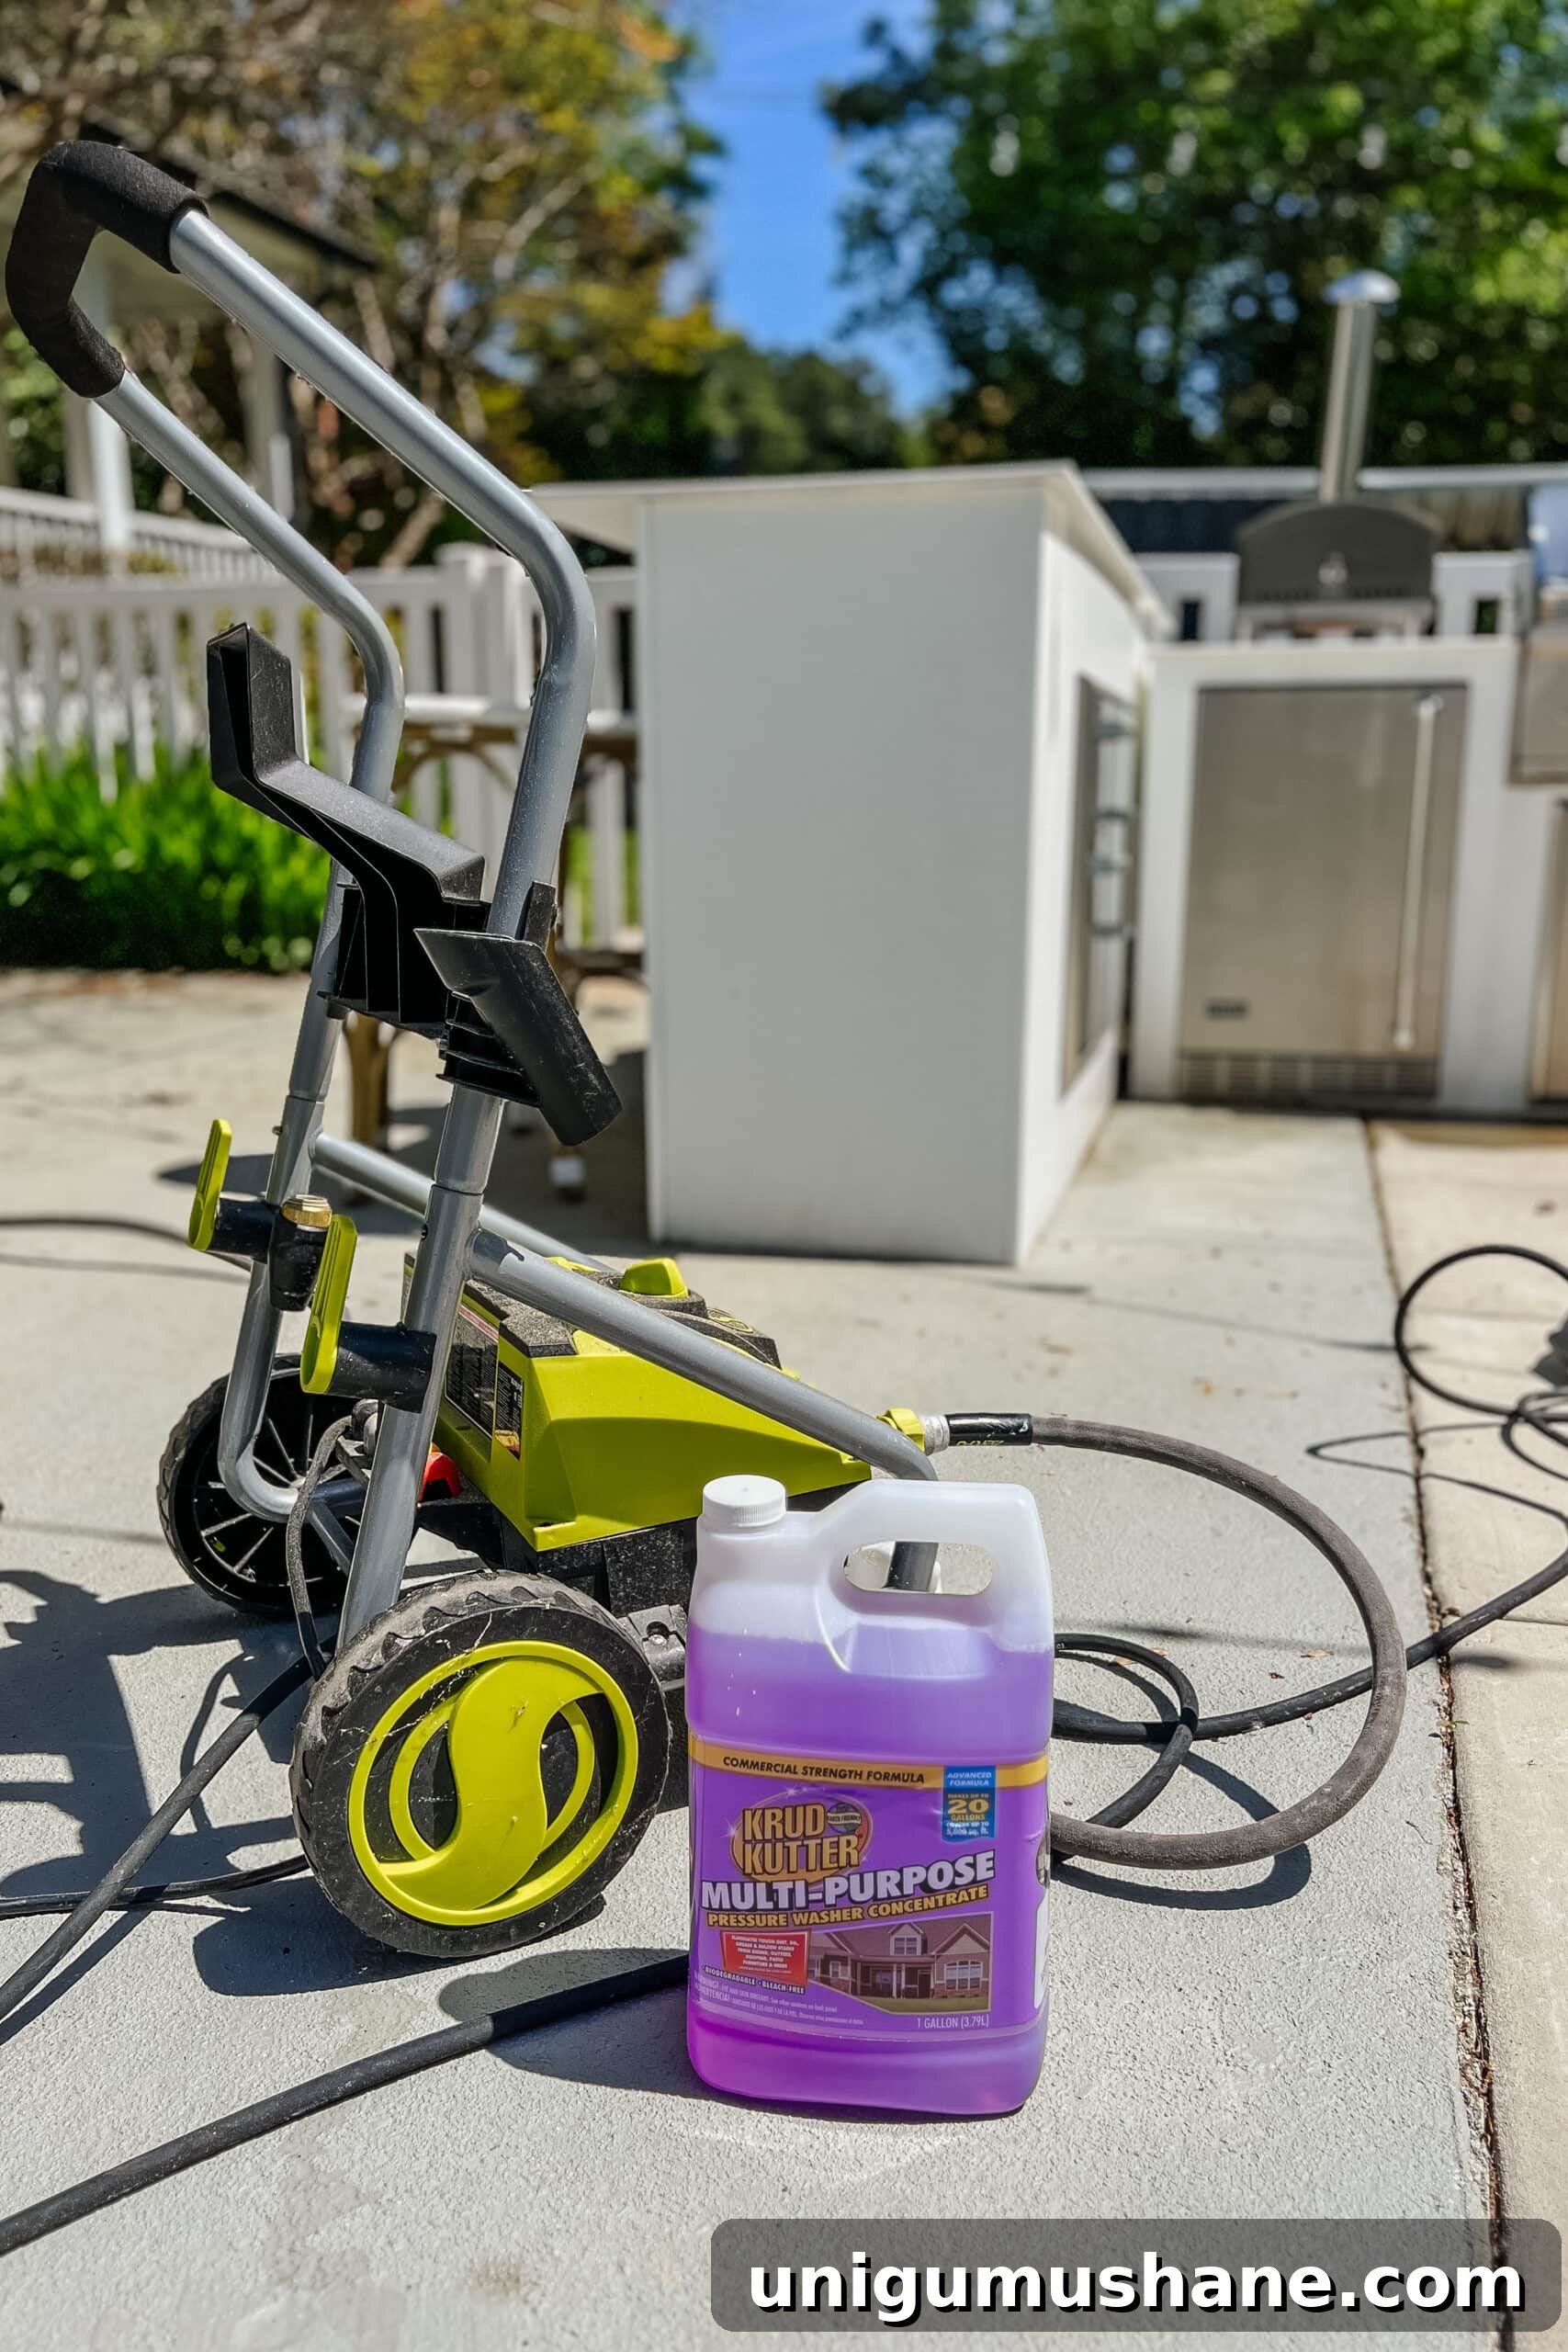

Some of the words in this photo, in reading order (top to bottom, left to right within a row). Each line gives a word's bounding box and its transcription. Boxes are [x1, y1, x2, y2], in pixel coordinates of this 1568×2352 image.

[723, 1756, 798, 1775] COMMERCIAL
[802, 1765, 863, 1780] STRENGTH
[866, 1770, 924, 1784] FORMULA
[947, 1771, 992, 1780] ADVANCED
[949, 1779, 989, 1787] FORMULA
[947, 1798, 989, 1815] 20
[951, 1814, 986, 1822] GALLONS
[743, 1803, 825, 1840] KRUD
[743, 1834, 860, 1875] KUTTER
[701, 1849, 996, 1910] MULTI-PURPOSE
[707, 1912, 788, 1928] PRESSURE
[792, 1905, 863, 1926] WASHER
[867, 1884, 989, 1919] CONCENTRATE
[705, 1965, 756, 1985] BIODEGRADABLE
[761, 1981, 806, 1995] BLEACH-FREE
[917, 2018, 921, 2028] 1
[924, 2017, 958, 2029] GALLON
[961, 2013, 989, 2030] (3.79L)
